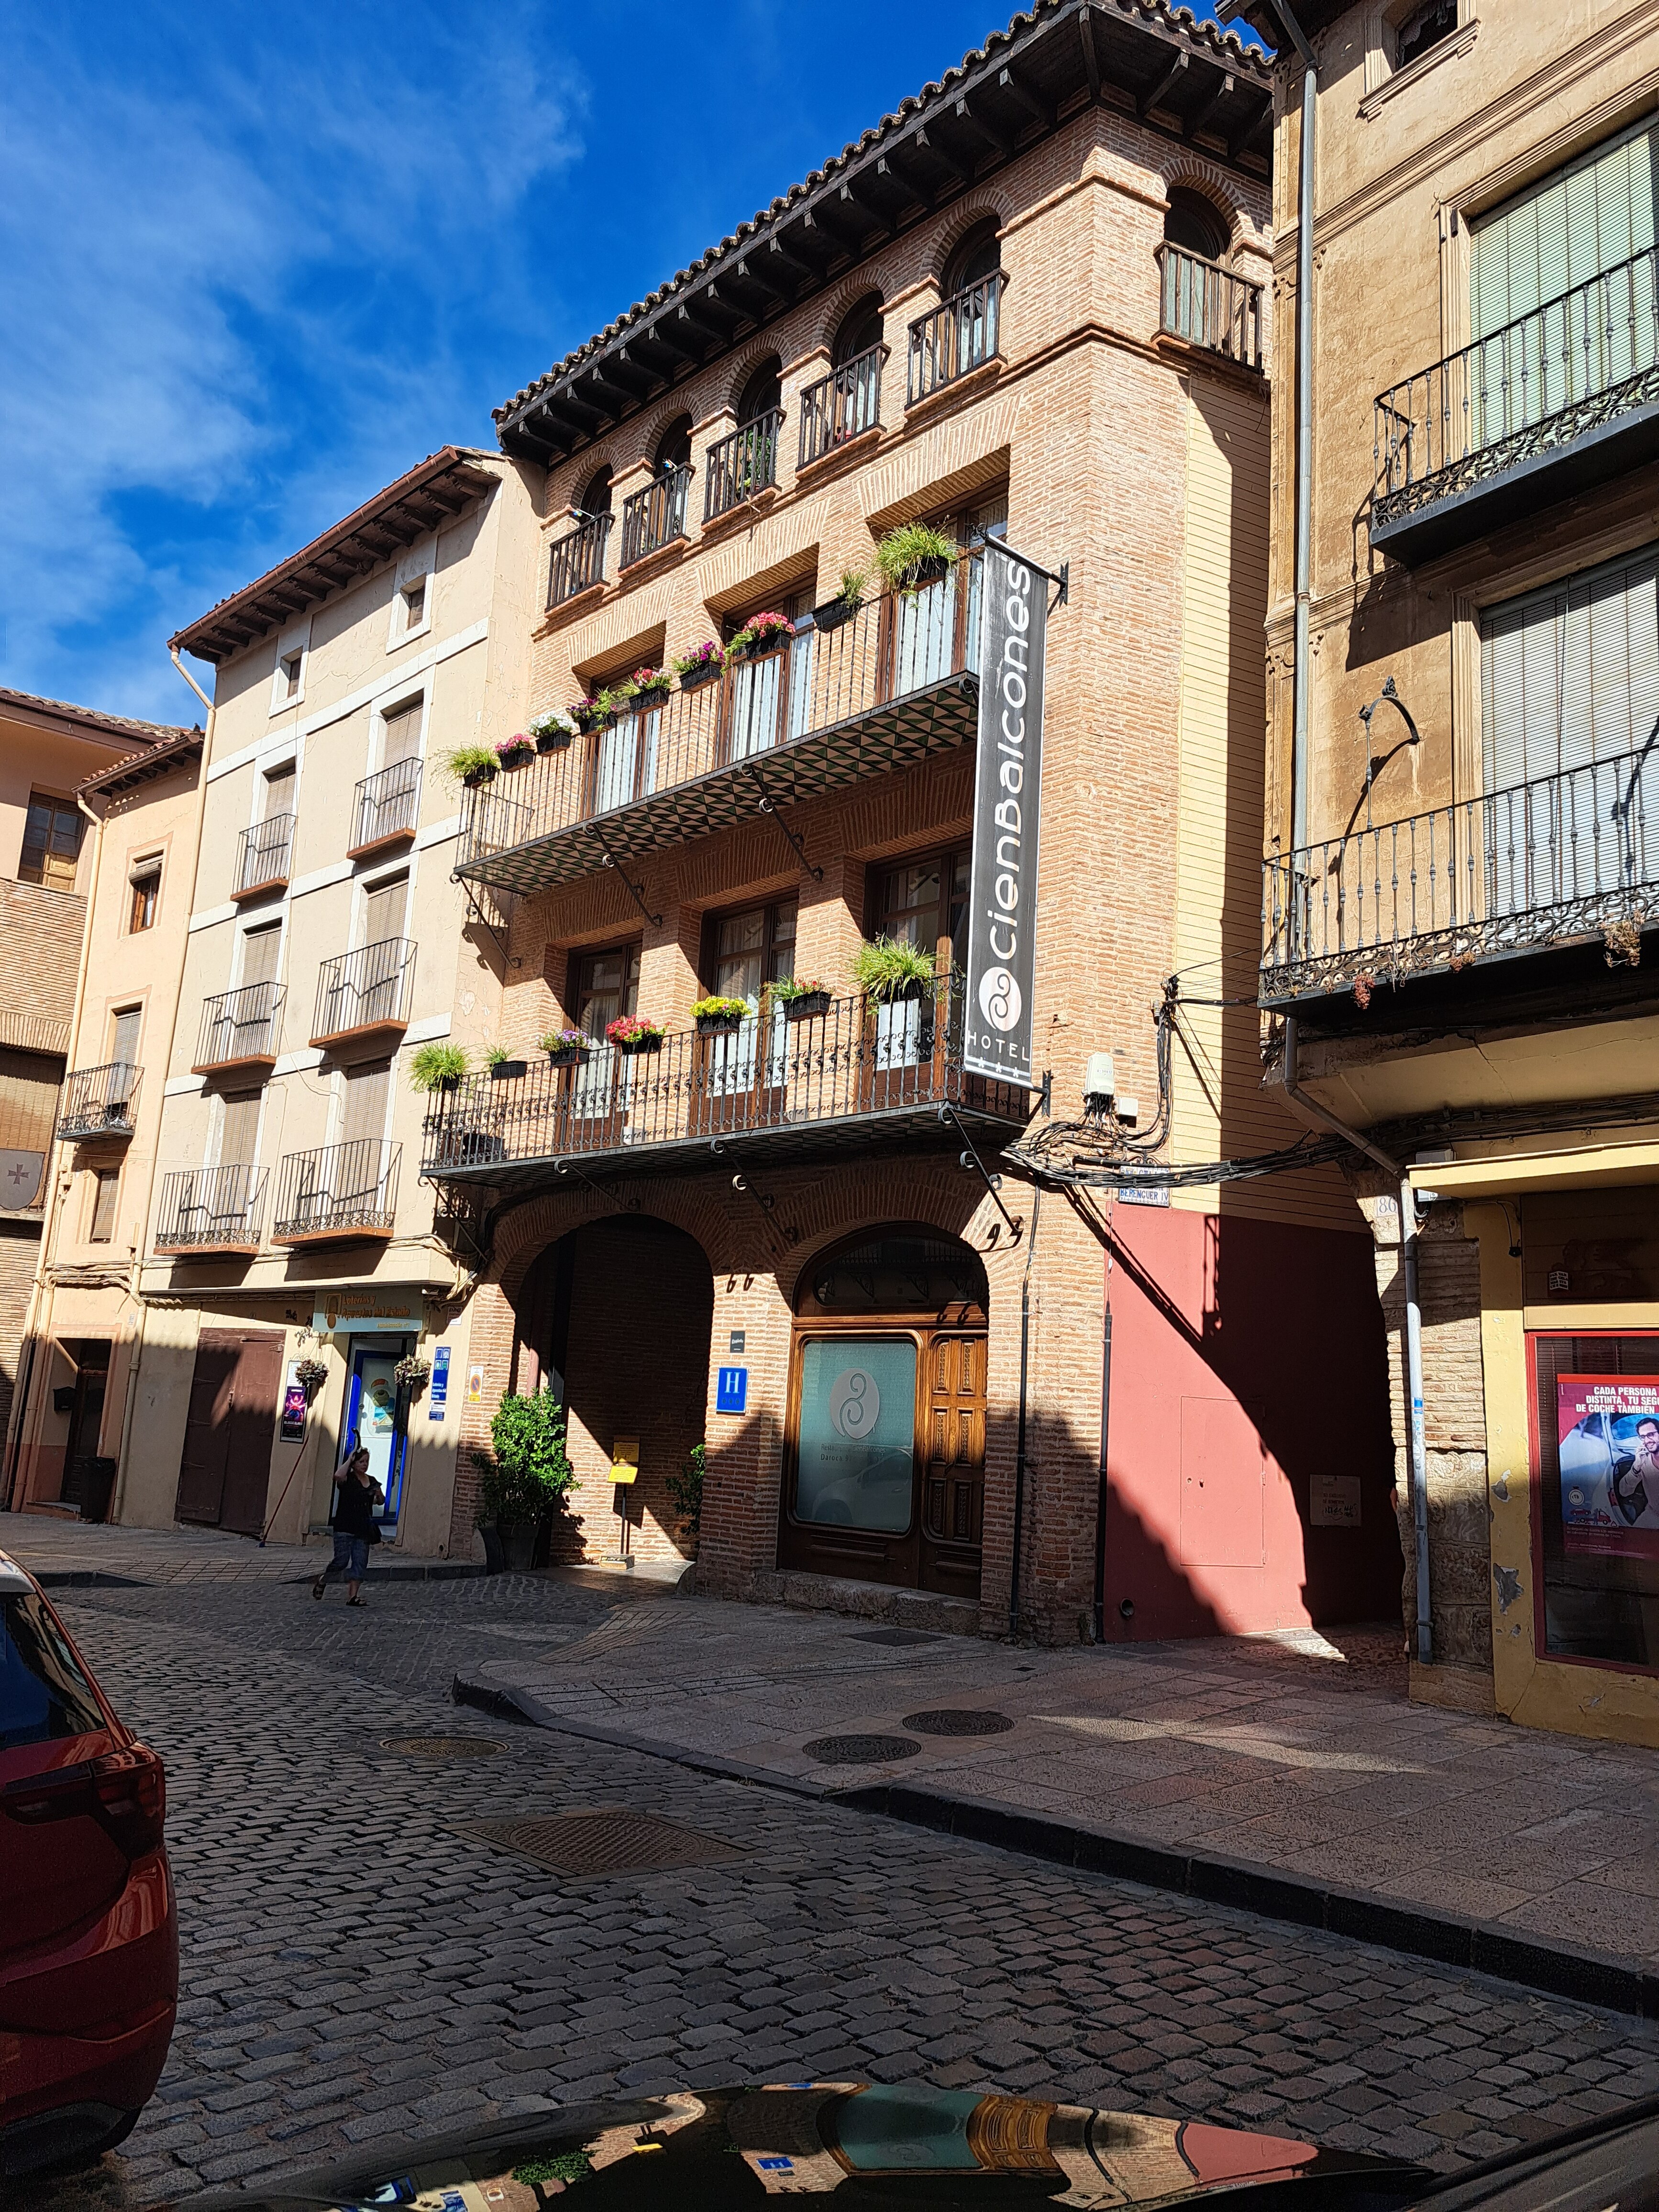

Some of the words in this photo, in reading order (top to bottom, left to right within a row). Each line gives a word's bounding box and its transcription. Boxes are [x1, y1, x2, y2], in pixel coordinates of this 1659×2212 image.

[967, 1030, 1030, 1062] HOTEL
[1120, 1188, 1158, 1200] BERENGUER
[1161, 1192, 1169, 1201] IV
[1379, 1195, 1397, 1214] 86
[343, 1294, 370, 1305] Loterías
[371, 1295, 376, 1306] y
[342, 1308, 373, 1321] Apuestas
[374, 1306, 385, 1317] del
[386, 1305, 410, 1317] Estado
[724, 1371, 741, 1394] H
[1594, 1386, 1616, 1395] CADA
[1618, 1387, 1657, 1396] PERSONA
[1586, 1395, 1625, 1405] DISTINTA,
[1627, 1396, 1639, 1405] TU
[1576, 1404, 1586, 1413] DE
[1588, 1404, 1615, 1414] COCHE
[1617, 1404, 1655, 1415] TAMBIÉN
[820, 1453, 842, 1461] Daroca
